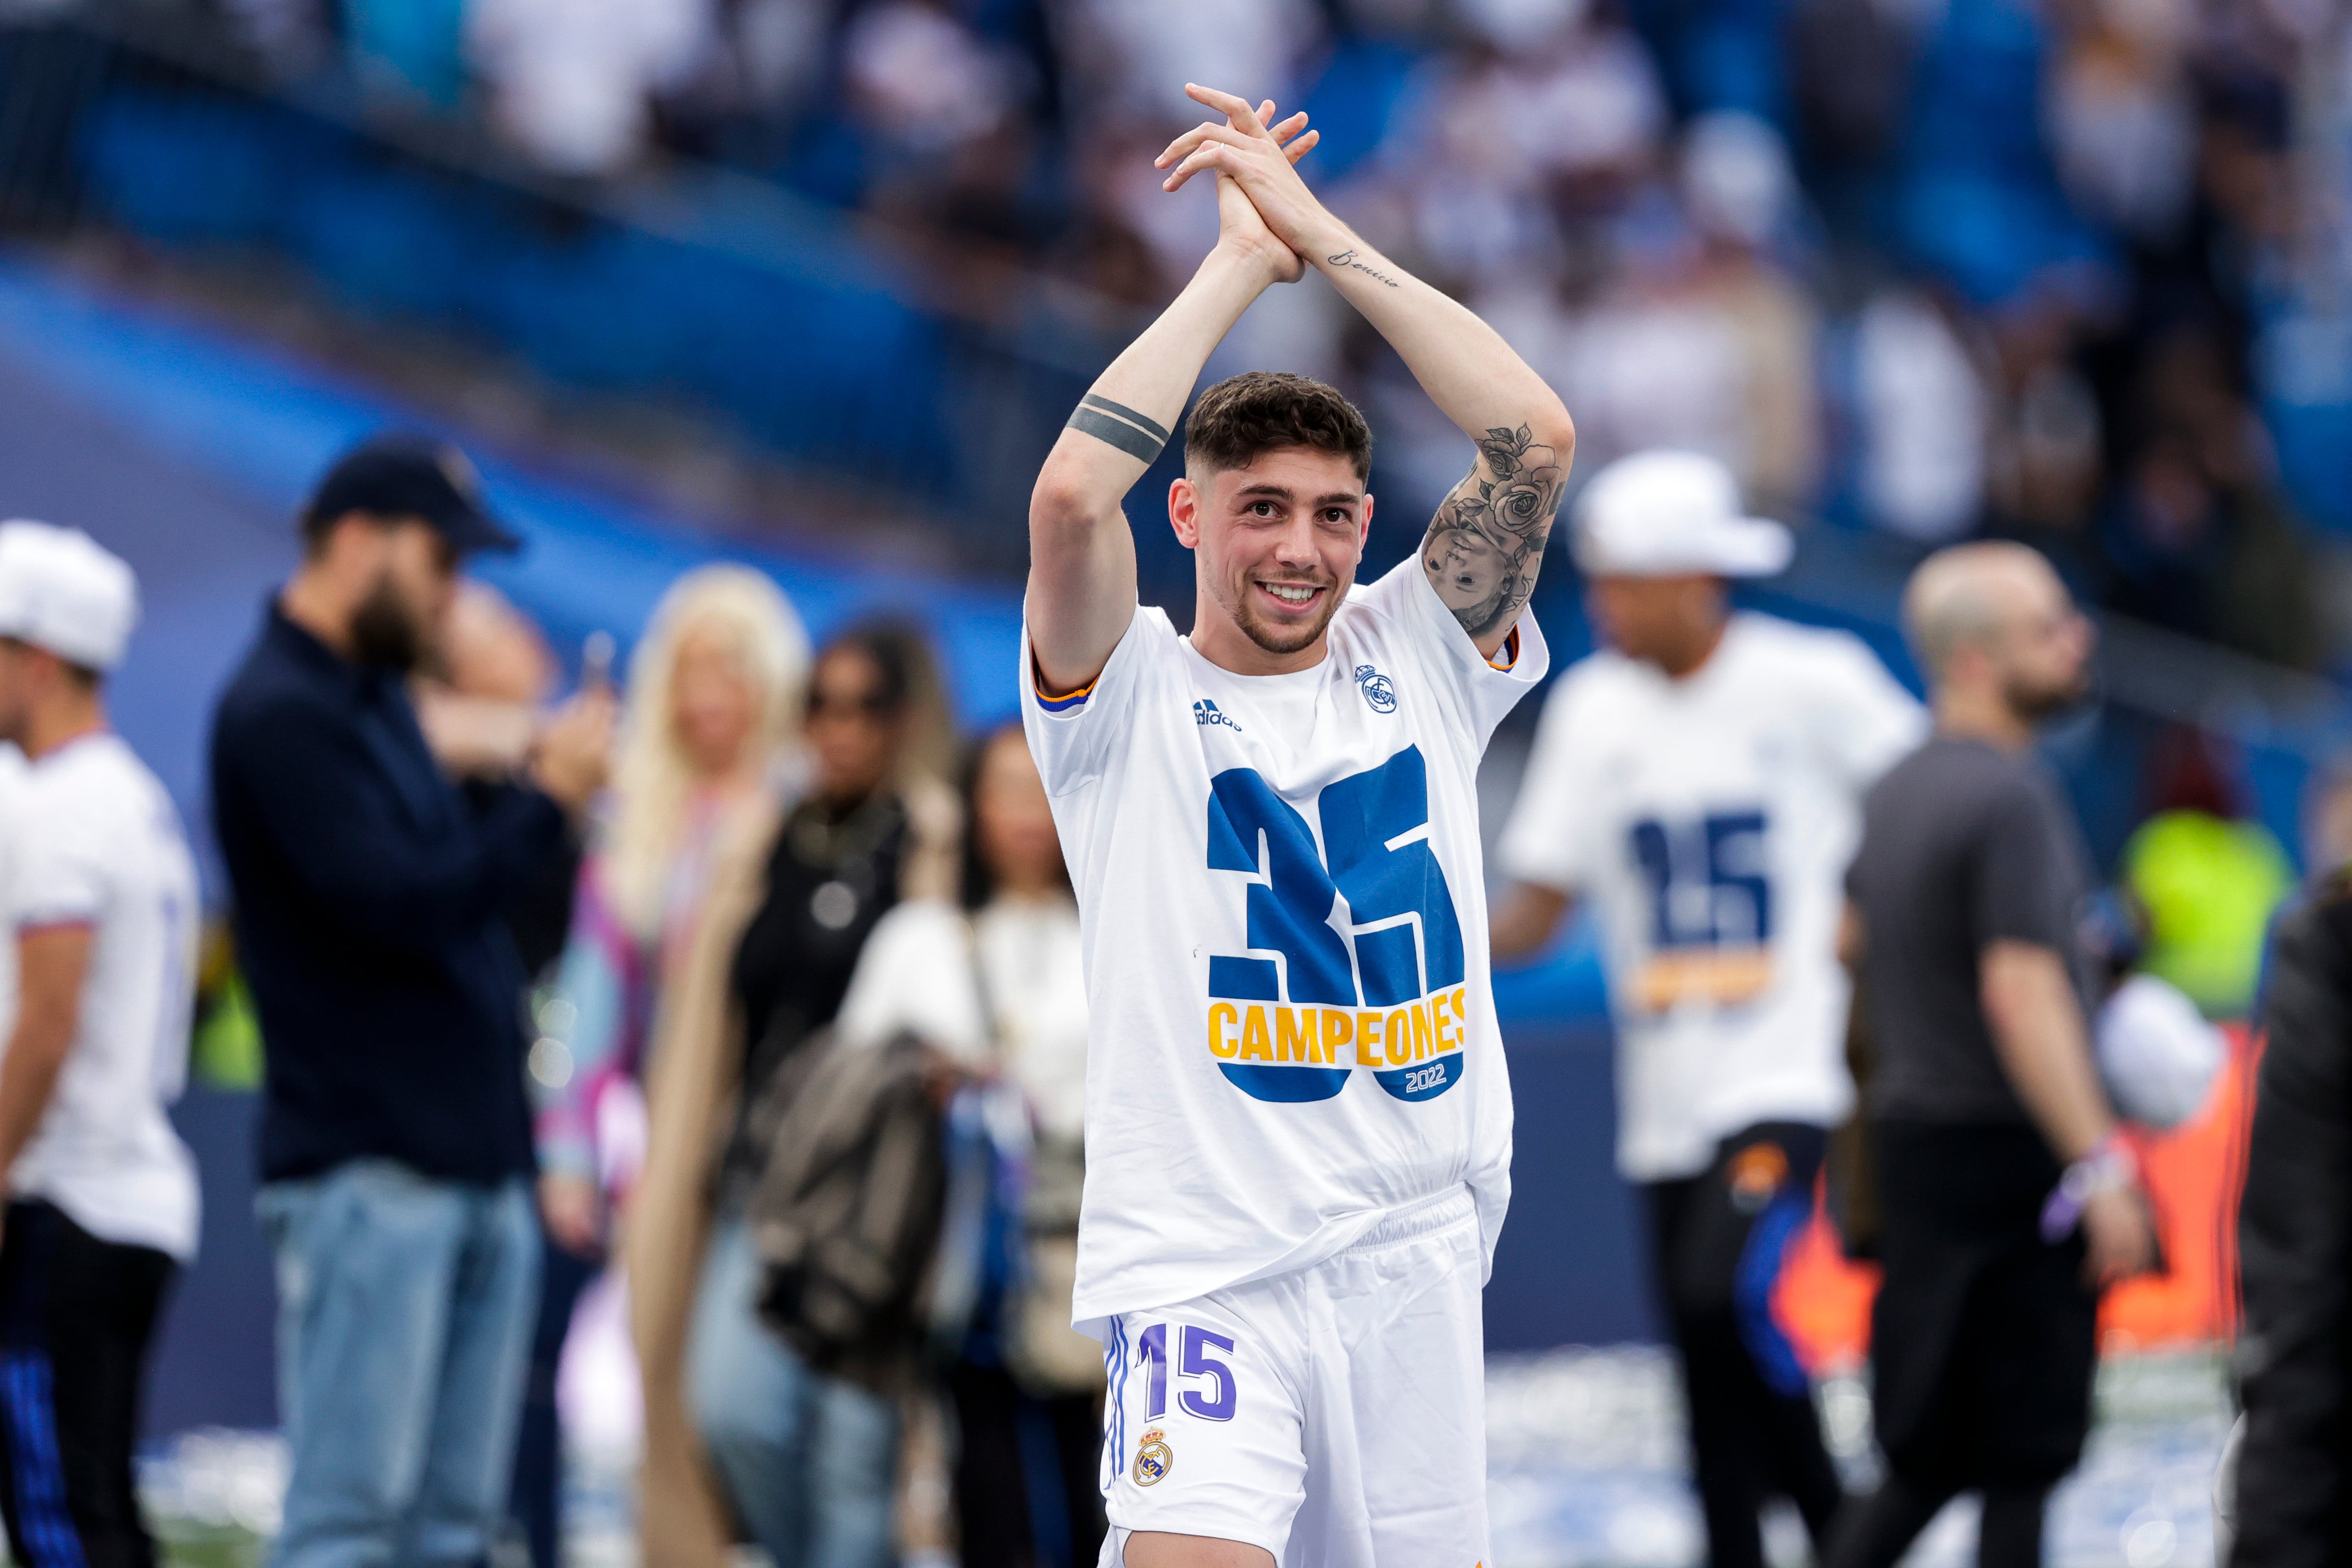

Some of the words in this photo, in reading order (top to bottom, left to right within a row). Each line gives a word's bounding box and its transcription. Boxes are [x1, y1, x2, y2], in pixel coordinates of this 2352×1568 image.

[1207, 743, 1465, 1103] 35
[1208, 987, 1465, 1067] CAMPEONES
[1405, 1063, 1447, 1093] 2022
[1134, 1323, 1236, 1423] 15
